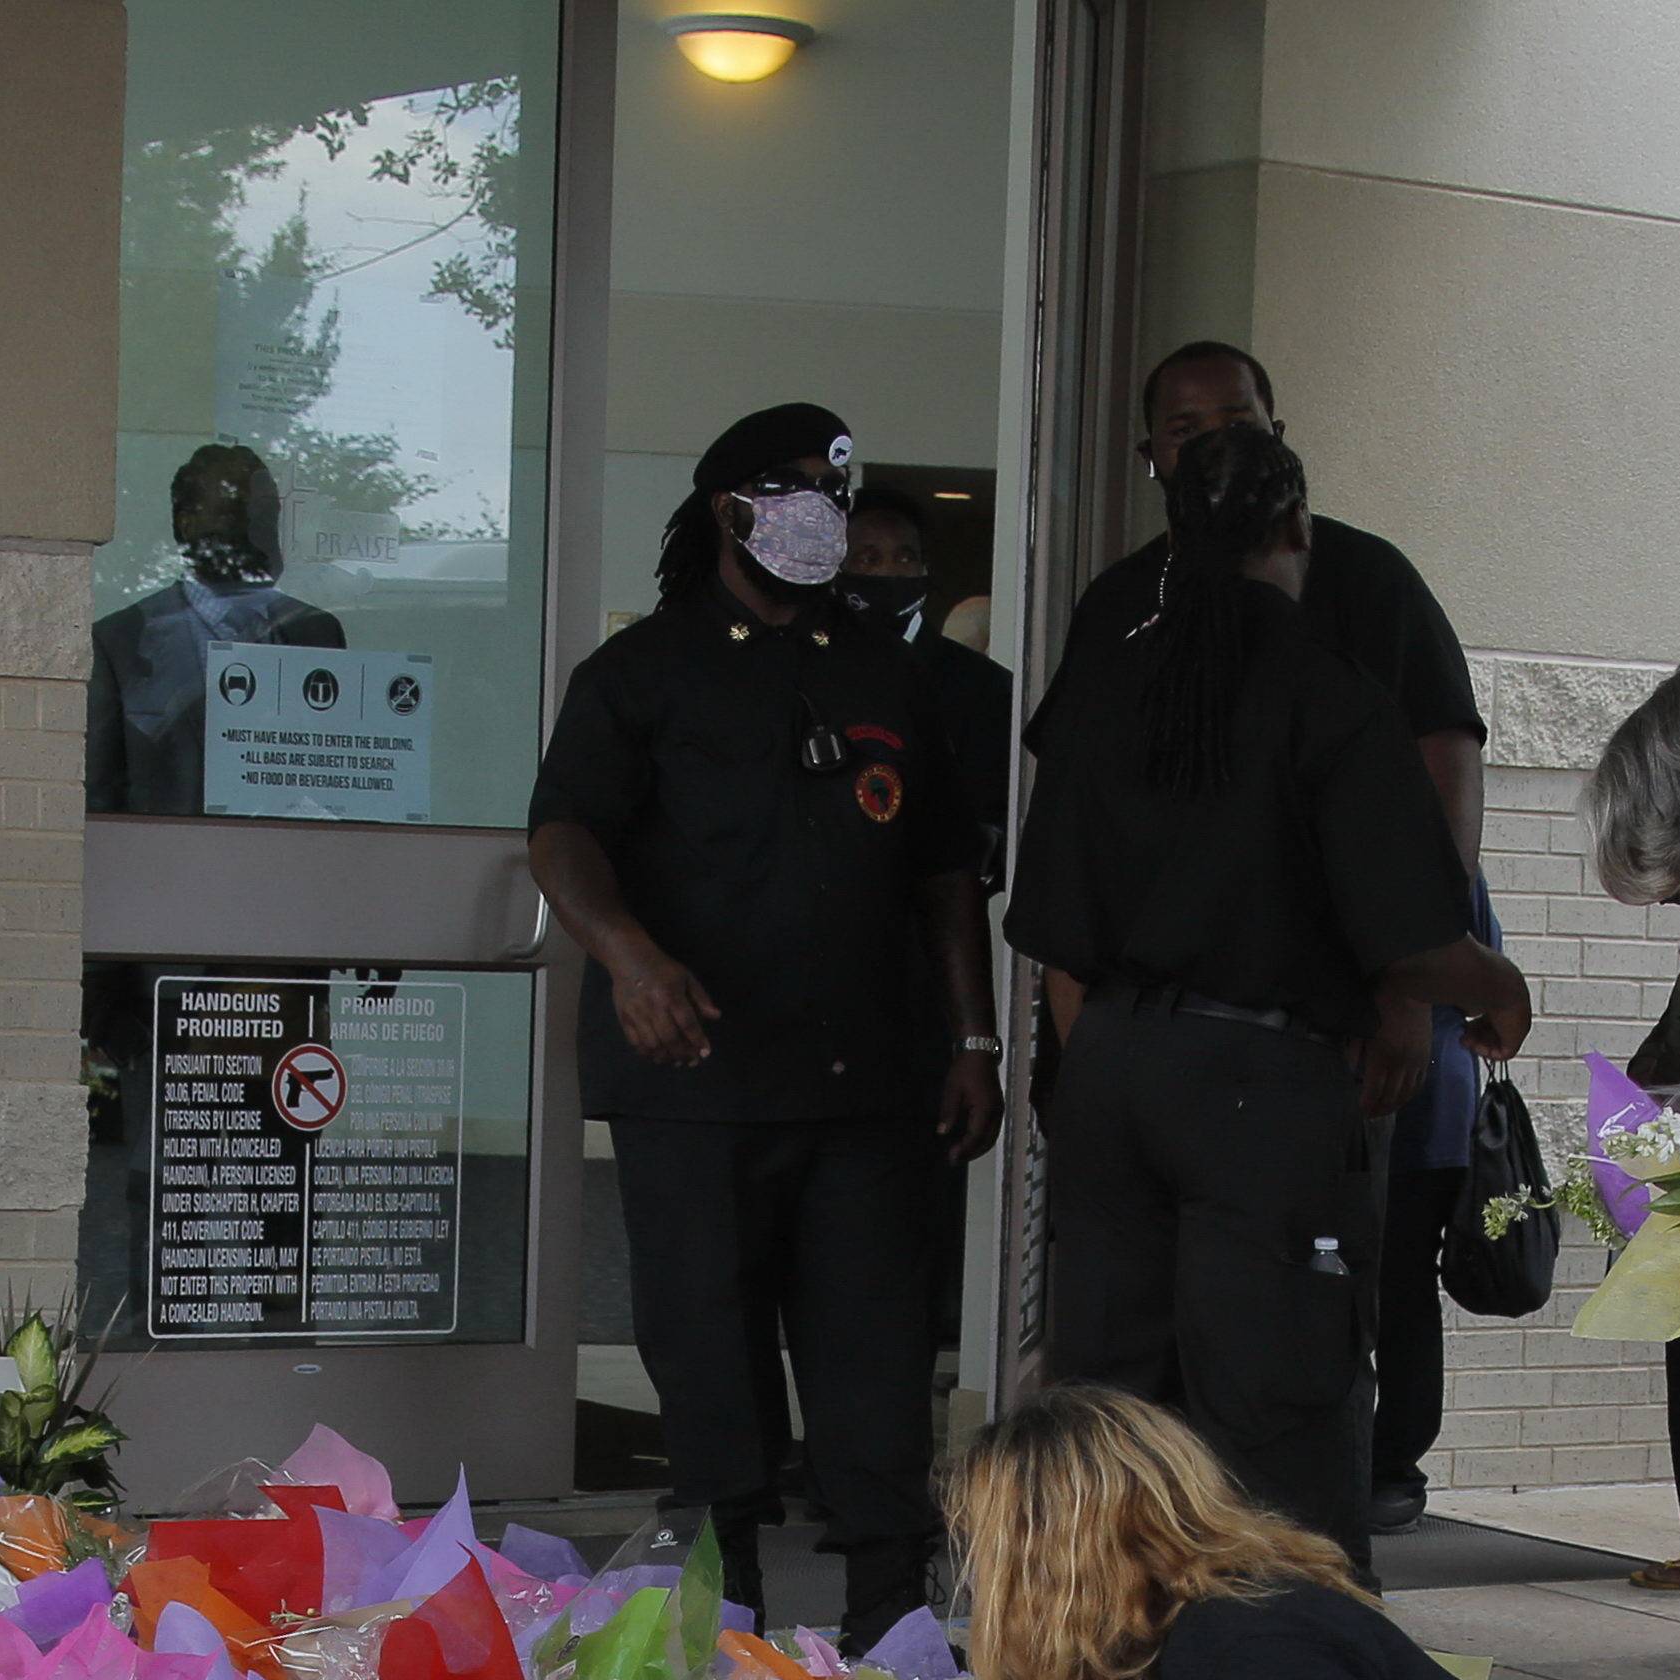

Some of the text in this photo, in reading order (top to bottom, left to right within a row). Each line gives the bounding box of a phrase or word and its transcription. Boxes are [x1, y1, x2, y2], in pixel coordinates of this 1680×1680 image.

[316, 531, 397, 560] PRAISE
[227, 729, 415, 751] MUST HAVE MASKS TO ENTER THE BUILDING.
[245, 751, 396, 771] ALL BAGS ARE SUBJECT TO SEARCH.
[246, 772, 395, 791] NO FOOD OR BEVERAGES ALLOWED.
[181, 992, 281, 1013] HANDGUNS
[341, 997, 435, 1017] PROHIBIDO
[176, 1018, 284, 1038] PROHIBITED
[330, 1022, 444, 1042] ARMAS DE FUEGO
[165, 1055, 263, 1075] PURSUANT TO SECTION
[192, 1083, 220, 1103] PENAL
[221, 1083, 245, 1103] CODE
[164, 1109, 262, 1131] (TRESPASS BY LICENSE
[163, 1138, 281, 1158] HOLDER WITH A CONCEALED
[211, 1165, 219, 1185] A
[220, 1165, 254, 1185] PERSON
[255, 1165, 296, 1185] LICENSED
[162, 1193, 191, 1213] UNDER
[193, 1193, 249, 1213] SUBCHAPTER
[260, 1193, 299, 1213] CHAPTER
[162, 1220, 264, 1243] 411, GOVERNMENT CODE
[161, 1246, 207, 1270] (HANDGUN
[208, 1248, 252, 1267] LICENSING
[279, 1248, 299, 1267] MAY
[160, 1275, 297, 1295] NOT ENTER THIS PROPERTY WITH
[160, 1303, 167, 1323] A
[168, 1303, 219, 1323] CONCEALED
